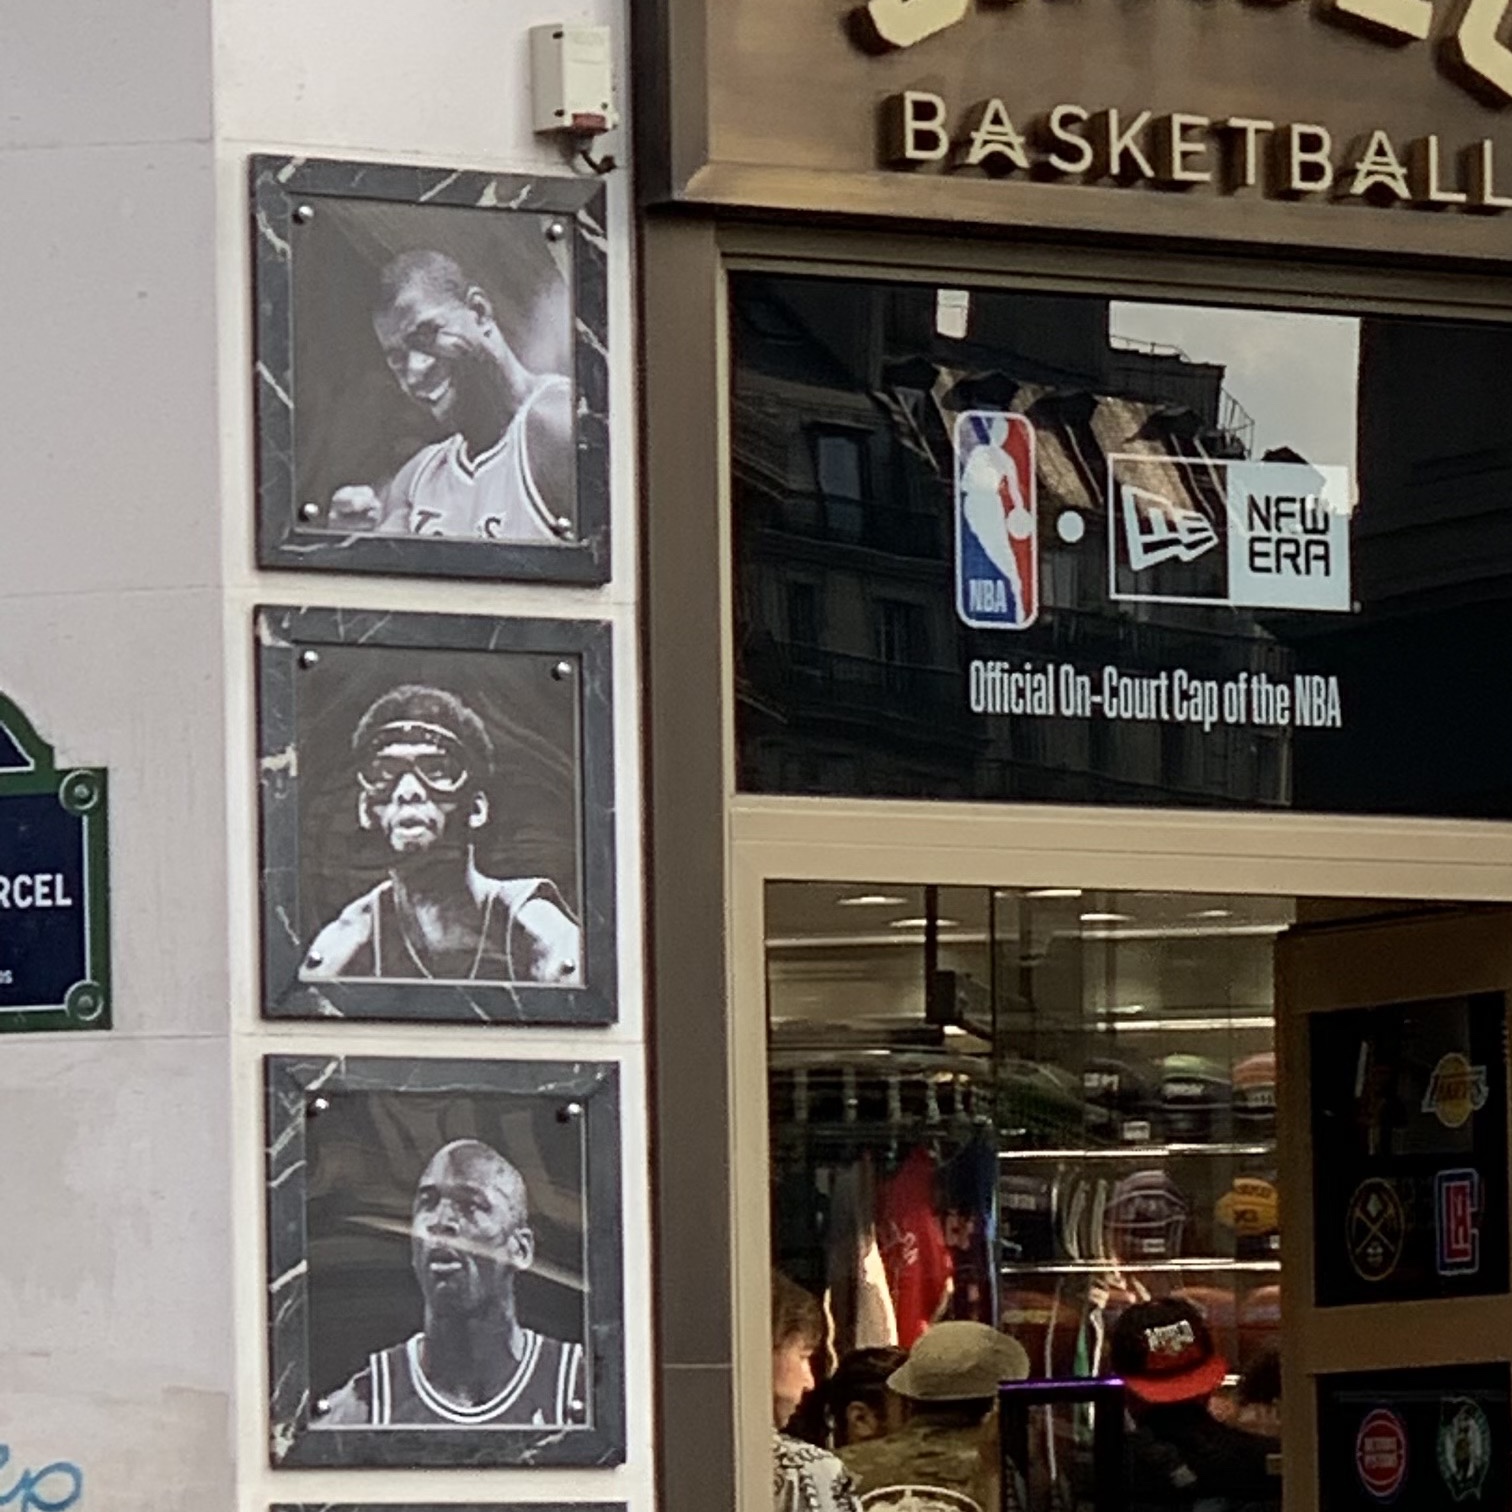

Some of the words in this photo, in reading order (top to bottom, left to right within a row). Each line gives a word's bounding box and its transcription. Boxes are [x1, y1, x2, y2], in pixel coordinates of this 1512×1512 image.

[1248, 536, 1330, 577] ERA
[969, 578, 1008, 614] NBA
[970, 660, 1055, 716] Official
[1059, 663, 1170, 720] On-Court
[1173, 668, 1219, 733] Cap
[1223, 672, 1249, 725] of
[1250, 673, 1290, 726] the
[1294, 674, 1342, 728] NBA
